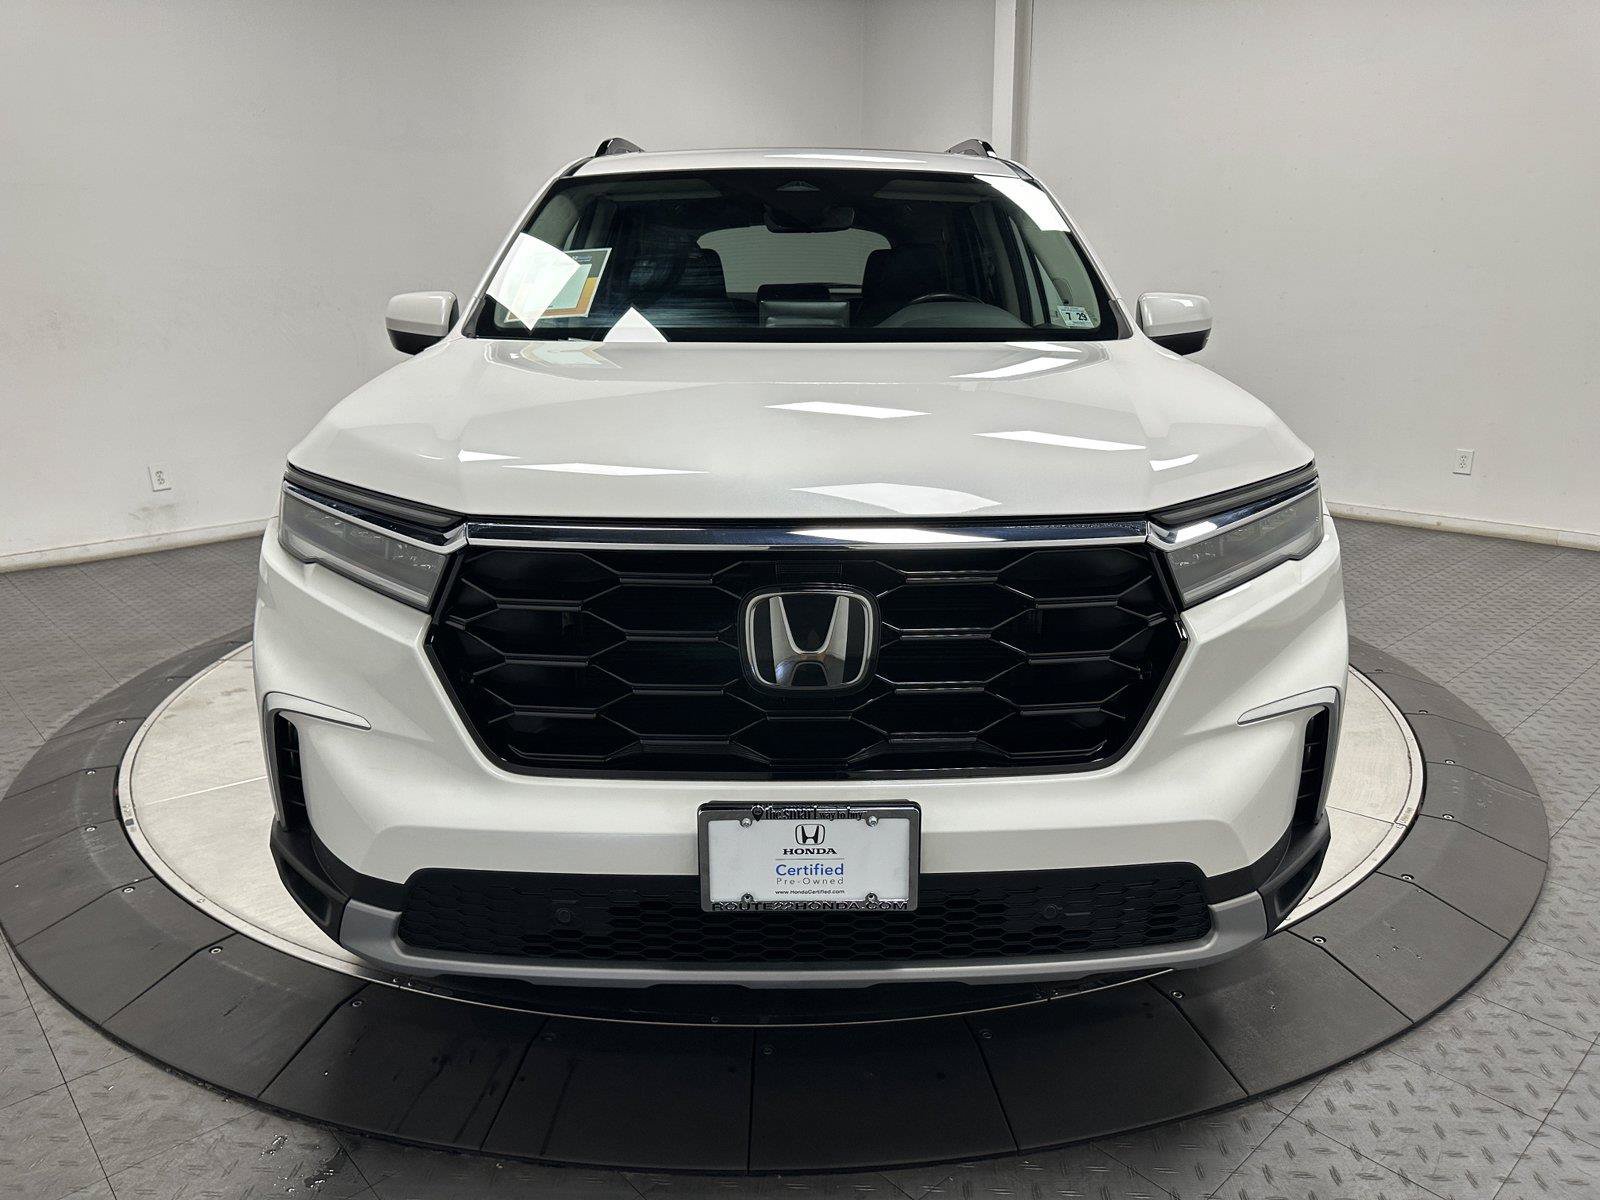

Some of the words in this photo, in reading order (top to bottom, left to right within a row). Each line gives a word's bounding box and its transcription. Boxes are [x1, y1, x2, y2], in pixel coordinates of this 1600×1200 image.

[765, 805, 782, 819] the
[783, 805, 817, 819] smart
[819, 810, 836, 821] way
[837, 808, 845, 819] to
[847, 805, 864, 821] buy
[783, 847, 838, 855] HONDA
[775, 863, 844, 876] Certified
[776, 877, 844, 885] Pre-Owned
